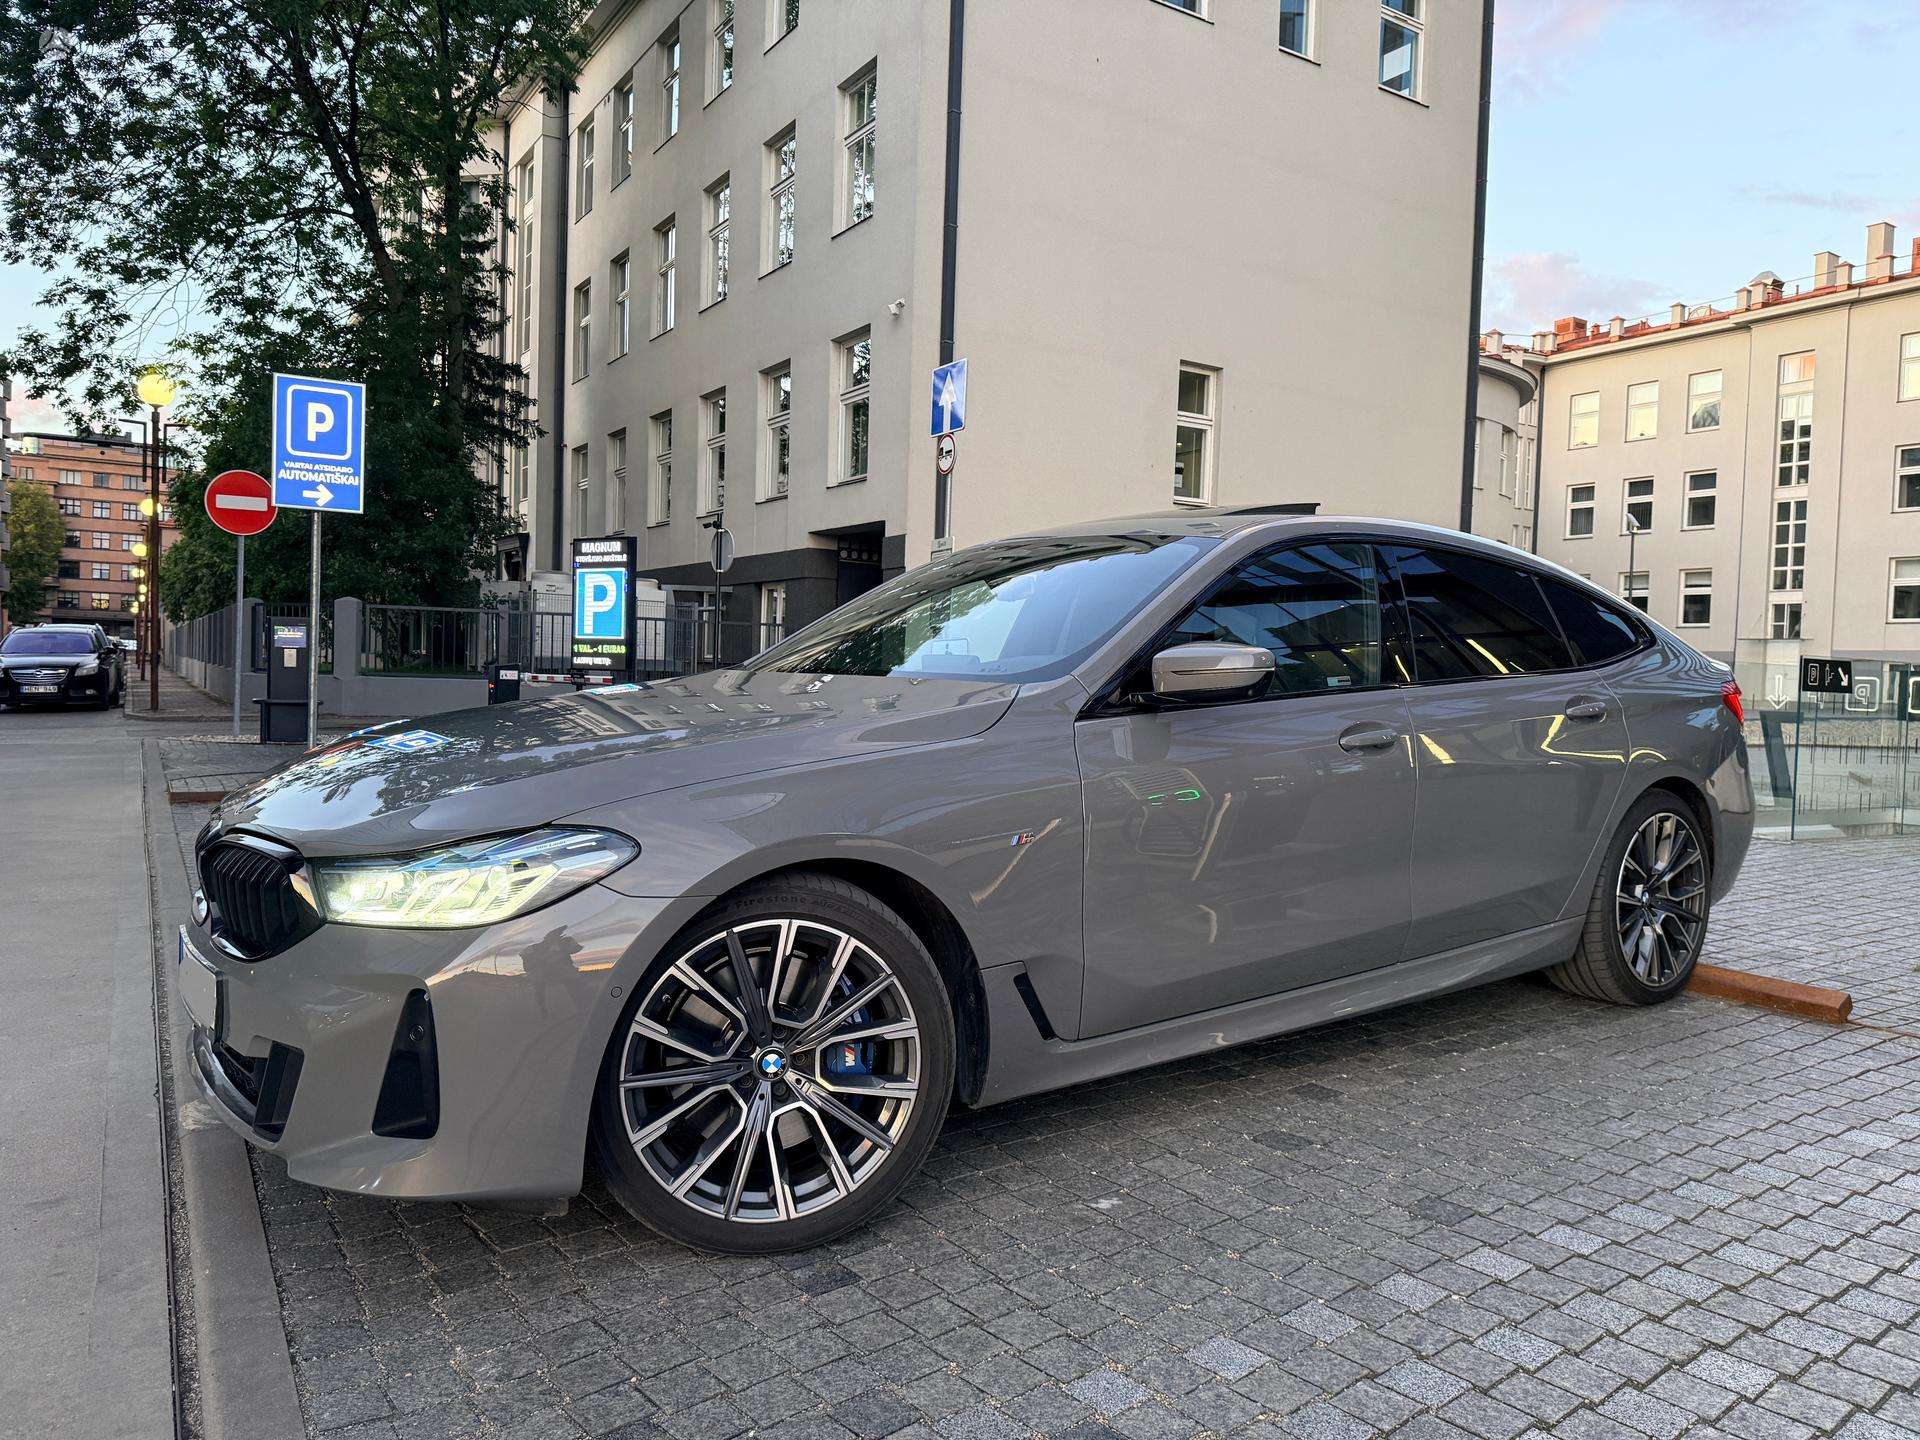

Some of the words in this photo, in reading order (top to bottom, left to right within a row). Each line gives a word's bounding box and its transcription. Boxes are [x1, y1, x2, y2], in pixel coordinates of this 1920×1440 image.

[307, 401, 335, 442] P
[284, 461, 313, 470] VARTAI
[313, 464, 353, 474] ATSIDARO
[278, 468, 359, 486] AUTOMATIŠKAI
[581, 541, 621, 553] MAGNUM
[584, 573, 616, 634] P
[733, 895, 807, 910] Firestone
